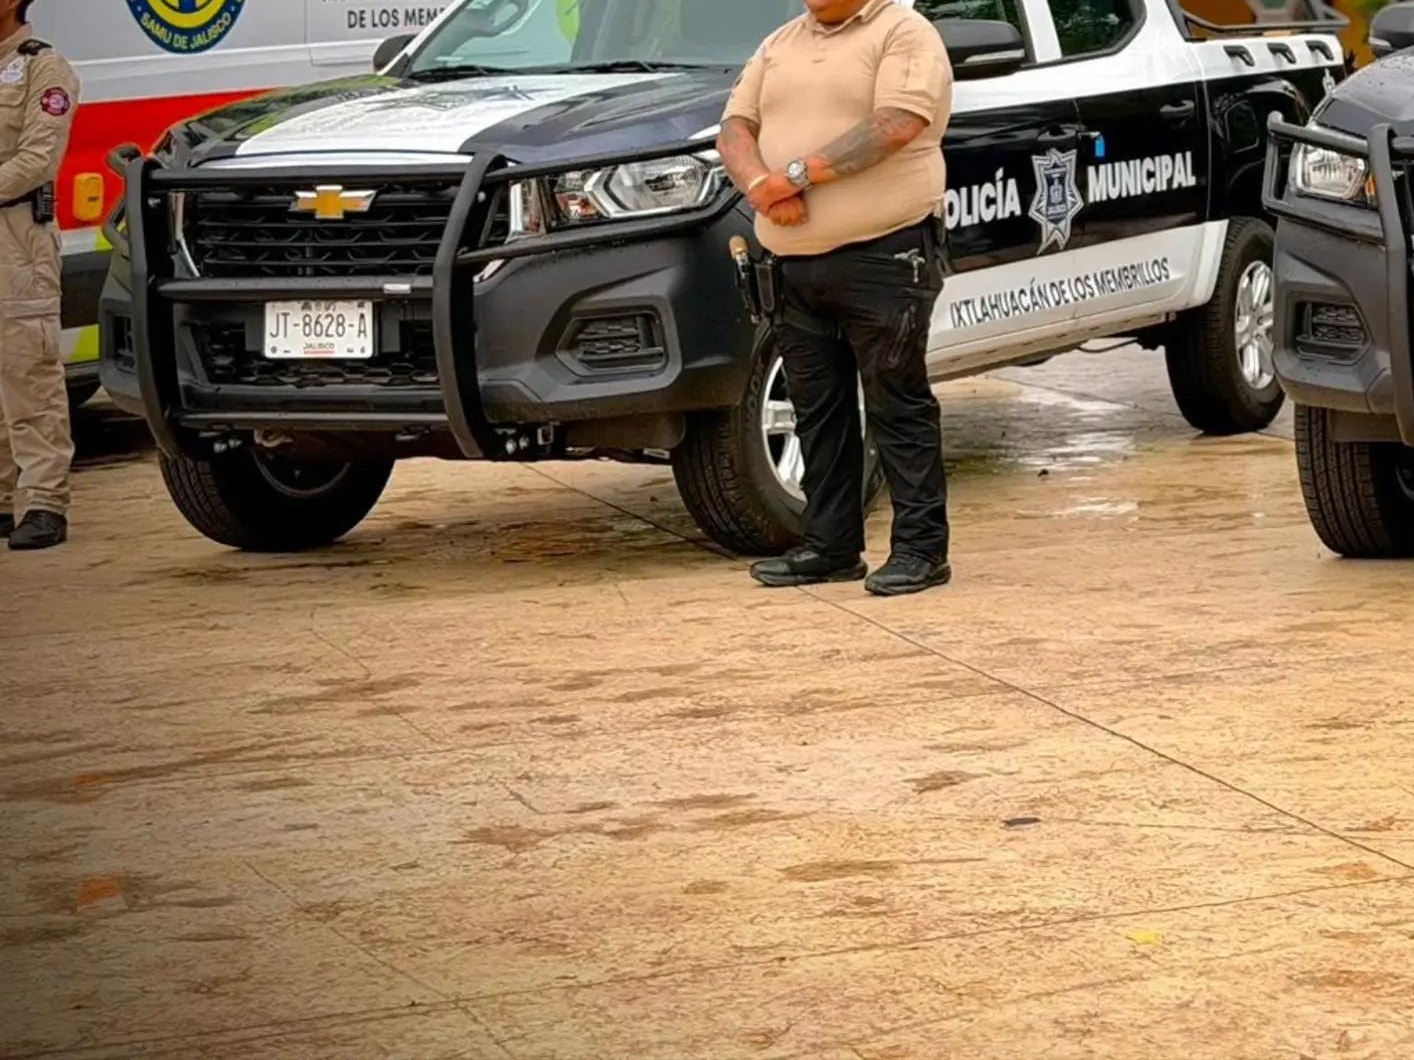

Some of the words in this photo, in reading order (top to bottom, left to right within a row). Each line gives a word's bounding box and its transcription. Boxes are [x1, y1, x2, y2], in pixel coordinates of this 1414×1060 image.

[141, 14, 172, 44] SAMU
[174, 35, 189, 49] DE
[190, 15, 232, 49] JALISCO
[347, 10, 366, 29] DE
[372, 8, 399, 28] LOS
[944, 166, 1021, 231] OLICÍA
[1087, 151, 1197, 203] MUNICIPAL
[950, 277, 1049, 329] IXTLAHUACÁN
[1050, 280, 1069, 306] DE
[1071, 274, 1095, 302] LOS
[1093, 257, 1170, 296] MEMBRILLOS
[270, 312, 367, 338] JT-8628-A
